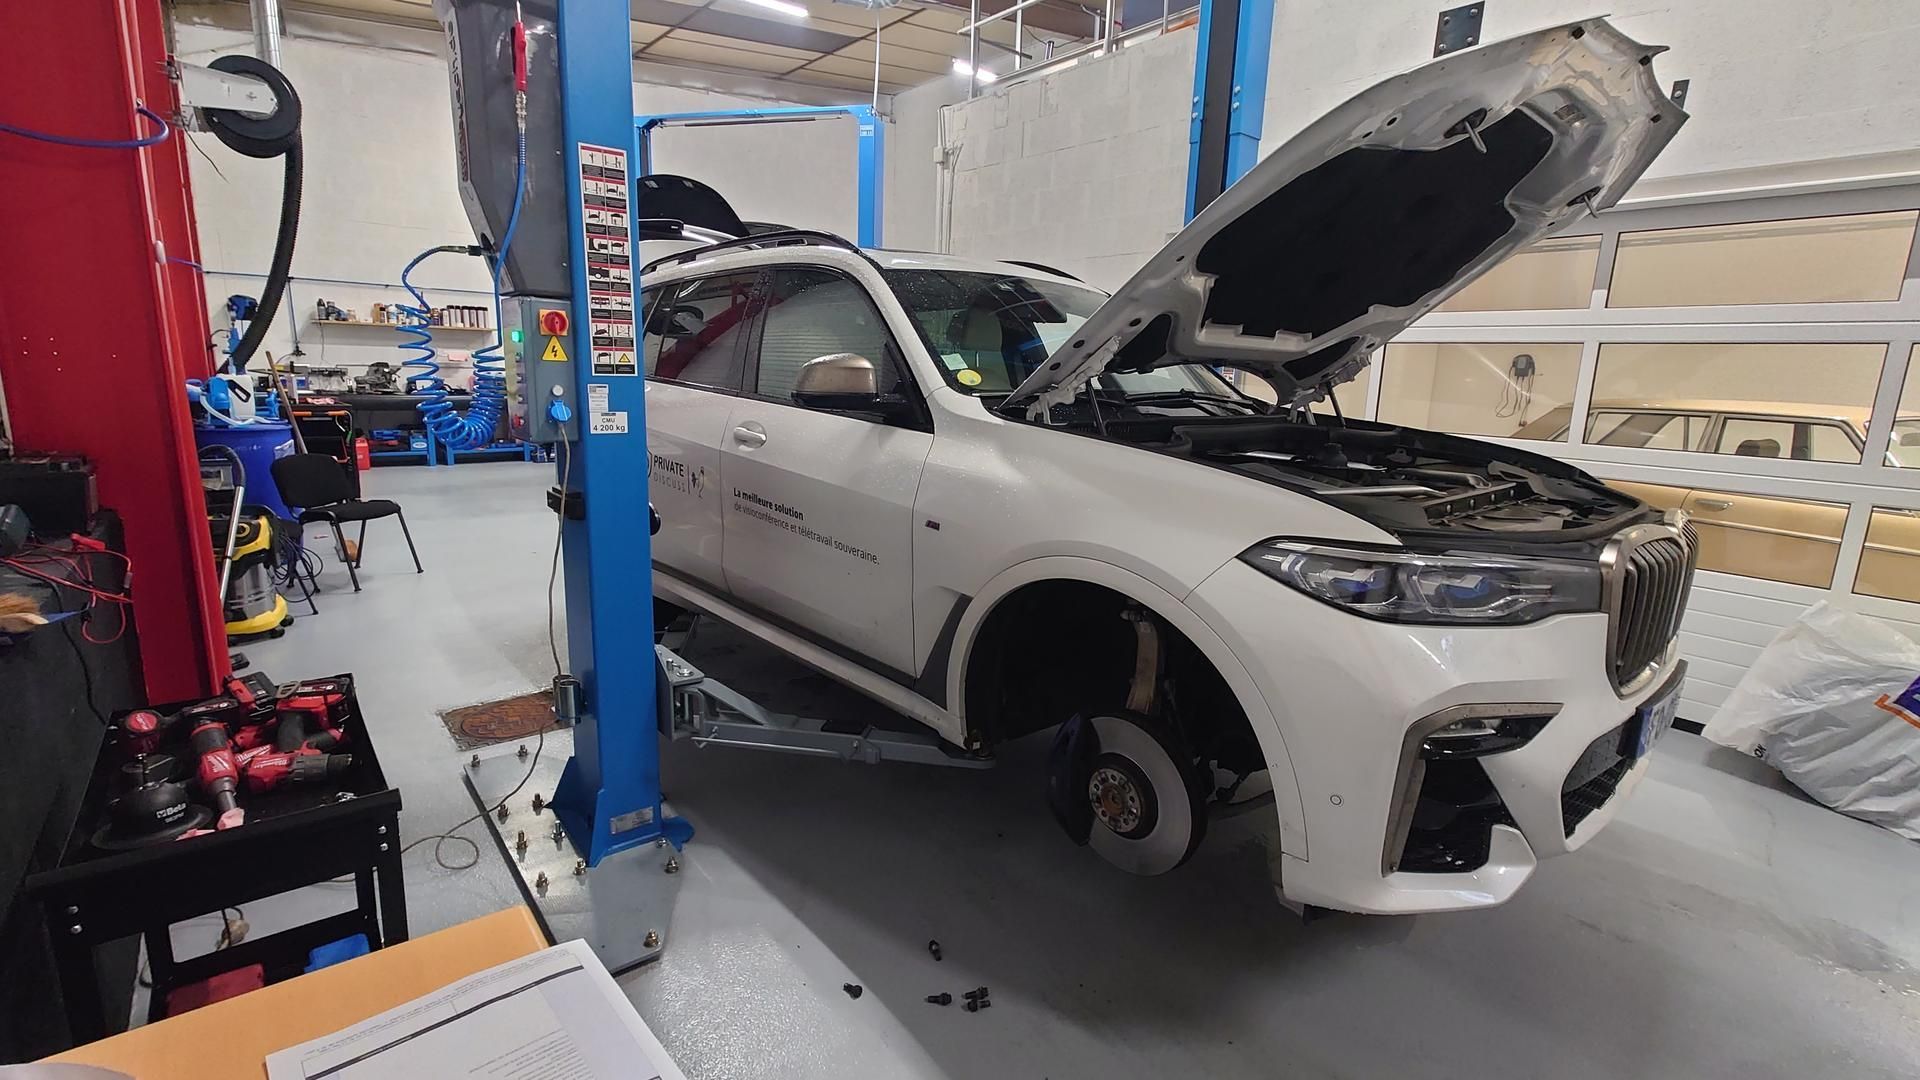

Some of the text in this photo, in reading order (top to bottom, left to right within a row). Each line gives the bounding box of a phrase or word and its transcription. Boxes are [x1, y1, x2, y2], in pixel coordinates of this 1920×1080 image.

[600, 424, 614, 432] 200
[616, 424, 626, 433] kg
[653, 455, 685, 478] PRIVATE
[733, 487, 804, 521] La meilleure solution
[734, 502, 880, 566] de visioconférence et télétravail souveraine.
[166, 802, 187, 816] Beta
